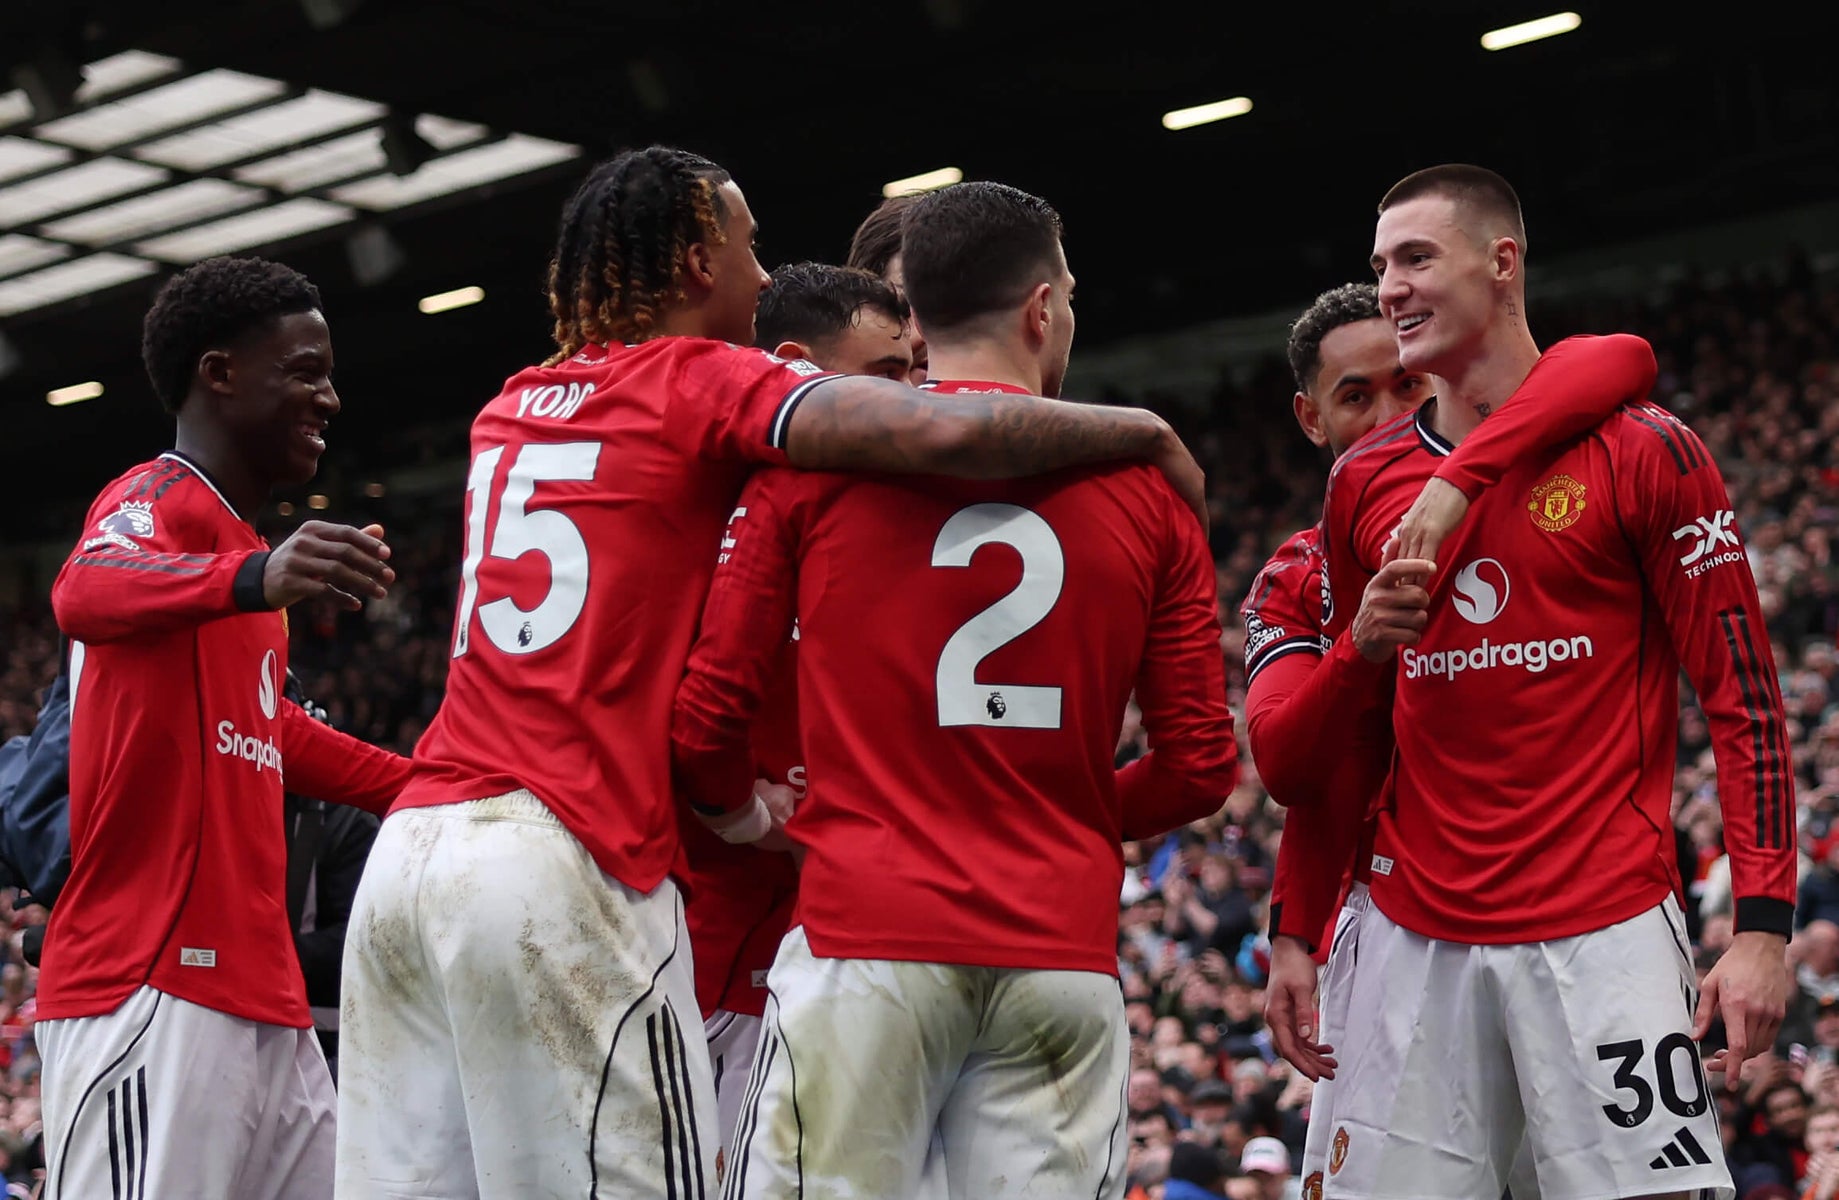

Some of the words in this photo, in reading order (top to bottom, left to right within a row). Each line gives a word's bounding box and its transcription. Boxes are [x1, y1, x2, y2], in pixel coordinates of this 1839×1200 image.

[452, 442, 602, 659] 15
[1538, 517, 1573, 529] UNITED
[930, 502, 1065, 729] 2
[1403, 635, 1593, 681] Snapdragon
[1596, 1032, 1708, 1128] 30
